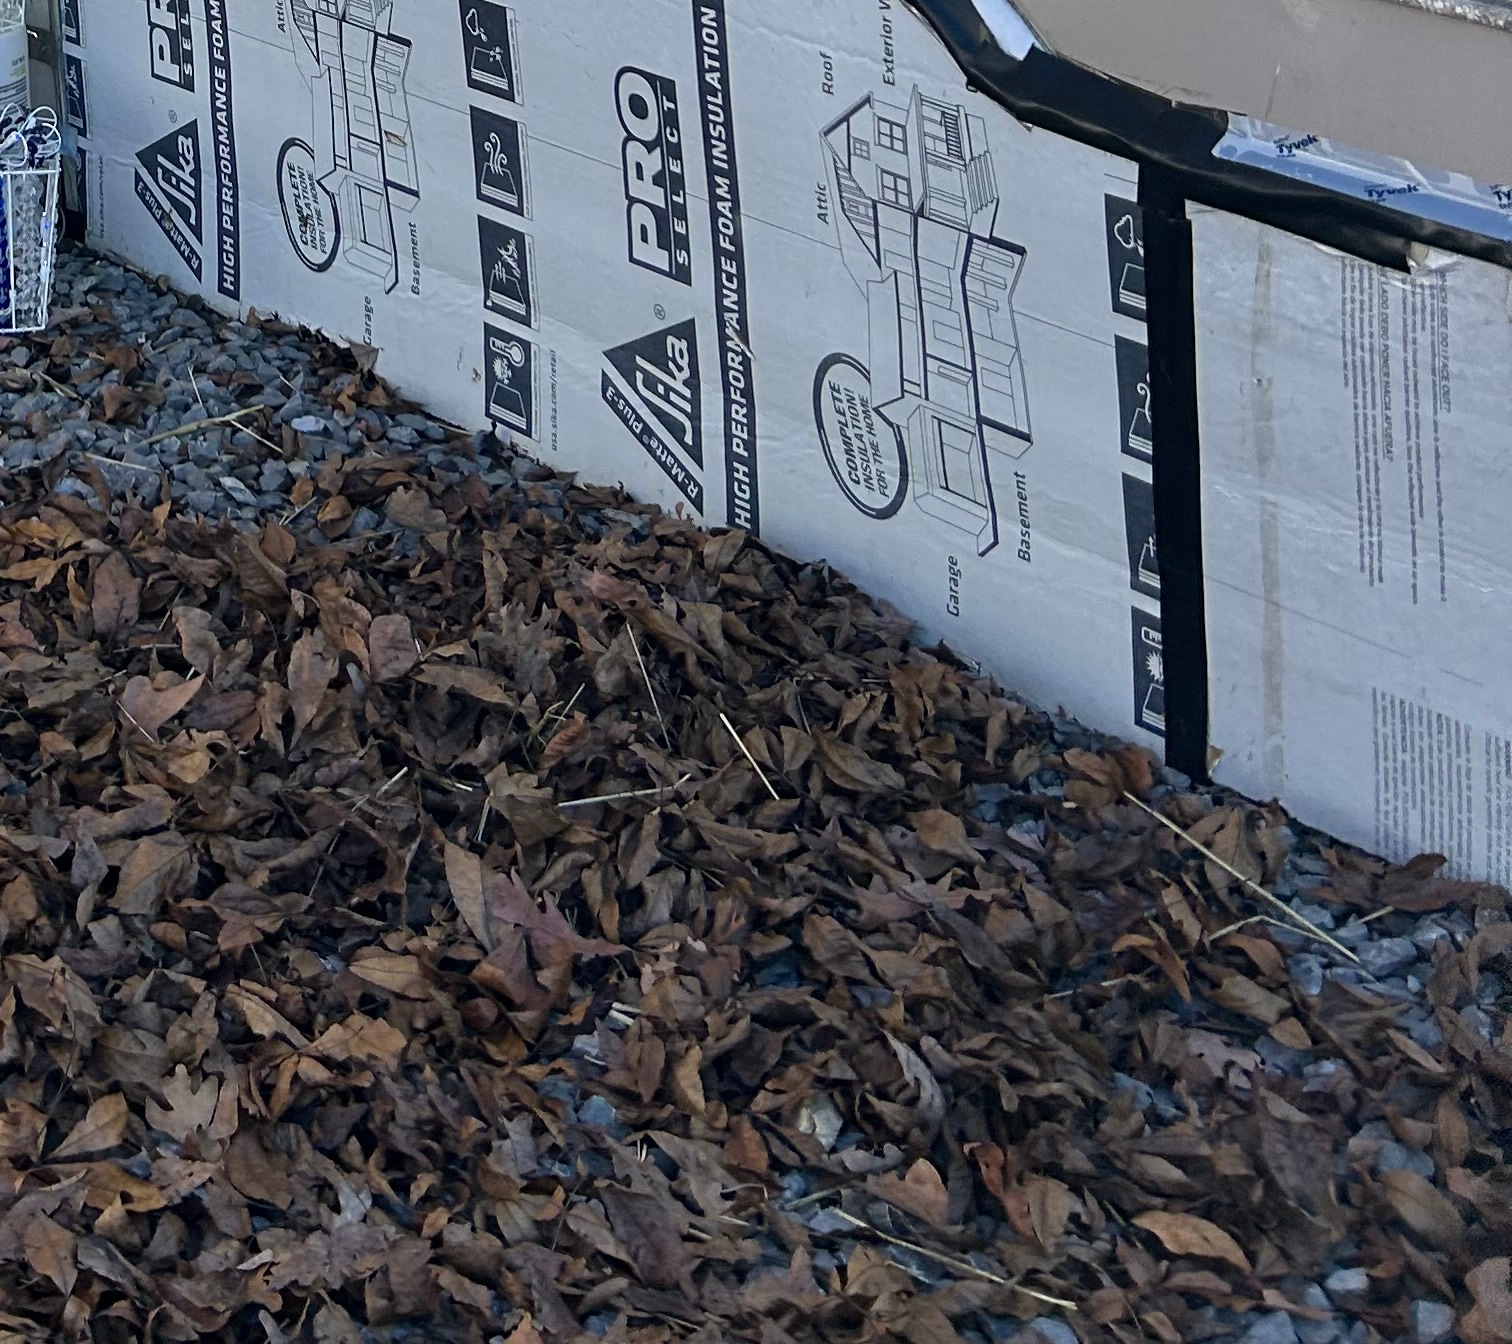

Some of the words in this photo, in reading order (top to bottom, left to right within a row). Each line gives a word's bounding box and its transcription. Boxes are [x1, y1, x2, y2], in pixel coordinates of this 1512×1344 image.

[208, 0, 225, 61] FOAM
[275, 0, 287, 34] Attic
[878, 14, 895, 86] Exterior
[700, 6, 729, 171] INSULATION
[818, 50, 834, 96] Roof
[214, 64, 235, 232] PERFORMANCE
[617, 70, 670, 273] PRO
[1276, 134, 1319, 154] Tyvek
[157, 134, 195, 227] Sika
[287, 161, 309, 246] COMPLETE
[663, 95, 689, 266] SELECT
[712, 174, 737, 252] FOAM
[816, 182, 830, 225] Attic
[1366, 183, 1420, 199] Tyvek
[222, 234, 236, 292] HIGH
[408, 221, 421, 296] Basement
[362, 294, 374, 346] Garage
[548, 349, 558, 452] usa.sika.com/retail
[604, 383, 642, 435] Plus-3
[634, 334, 693, 447] Sika
[857, 392, 879, 438] HOME
[828, 379, 861, 486] COMPLETE
[871, 438, 886, 469] THE
[734, 461, 752, 530] HIGH
[877, 468, 890, 499] FOR
[1012, 470, 1031, 564] Basement
[946, 554, 962, 618] Garage
